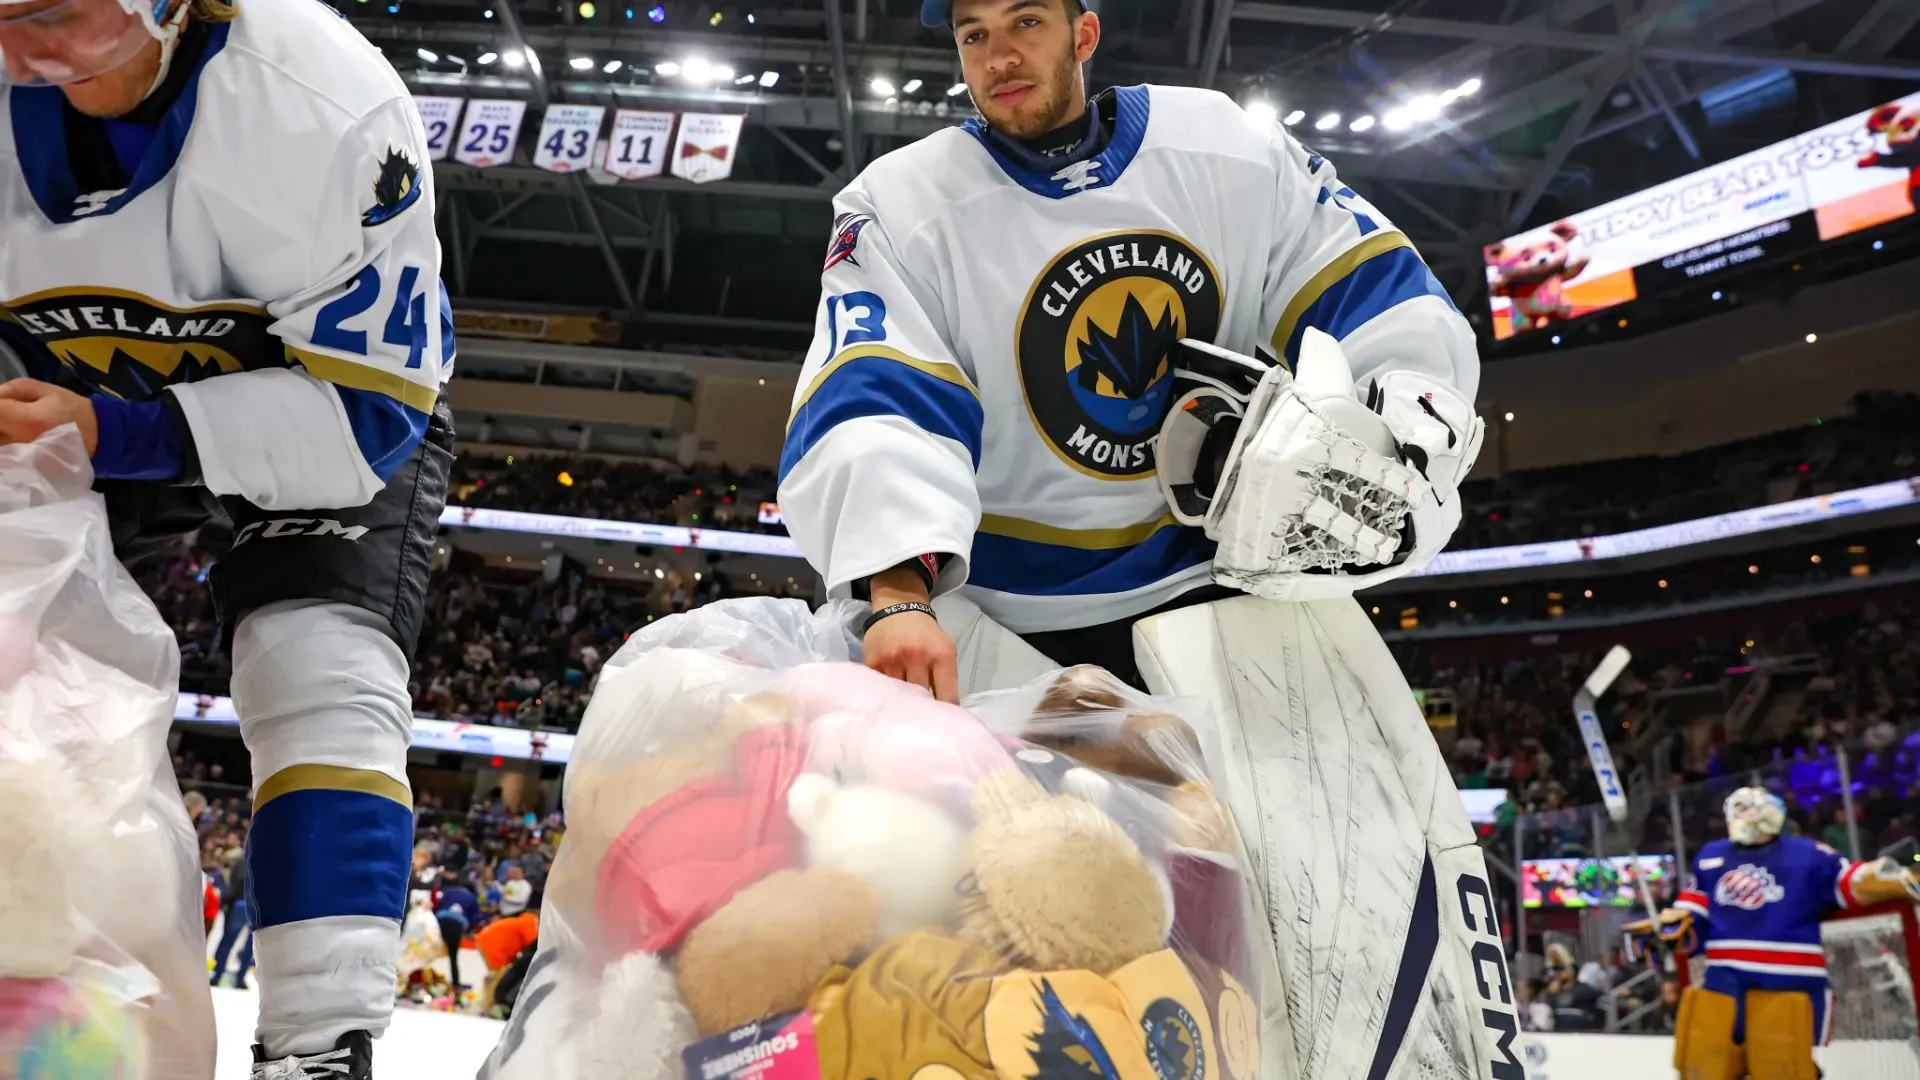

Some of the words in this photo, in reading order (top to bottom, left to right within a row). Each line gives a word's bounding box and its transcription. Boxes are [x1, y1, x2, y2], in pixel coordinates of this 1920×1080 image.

[426, 121, 448, 150] 2
[463, 123, 511, 154] 25
[543, 127, 590, 159] 43
[616, 134, 653, 164] 11
[1040, 138, 1082, 158] CM
[1580, 192, 1676, 247] TEDDY
[1679, 160, 1776, 214] BEAR
[1041, 242, 1205, 317] CLEVELAND
[310, 263, 428, 369] 24
[1065, 423, 1159, 468] MONST
[229, 517, 370, 552] CCM
[1581, 713, 1619, 797] CCM
[1456, 872, 1527, 1080] CCM
